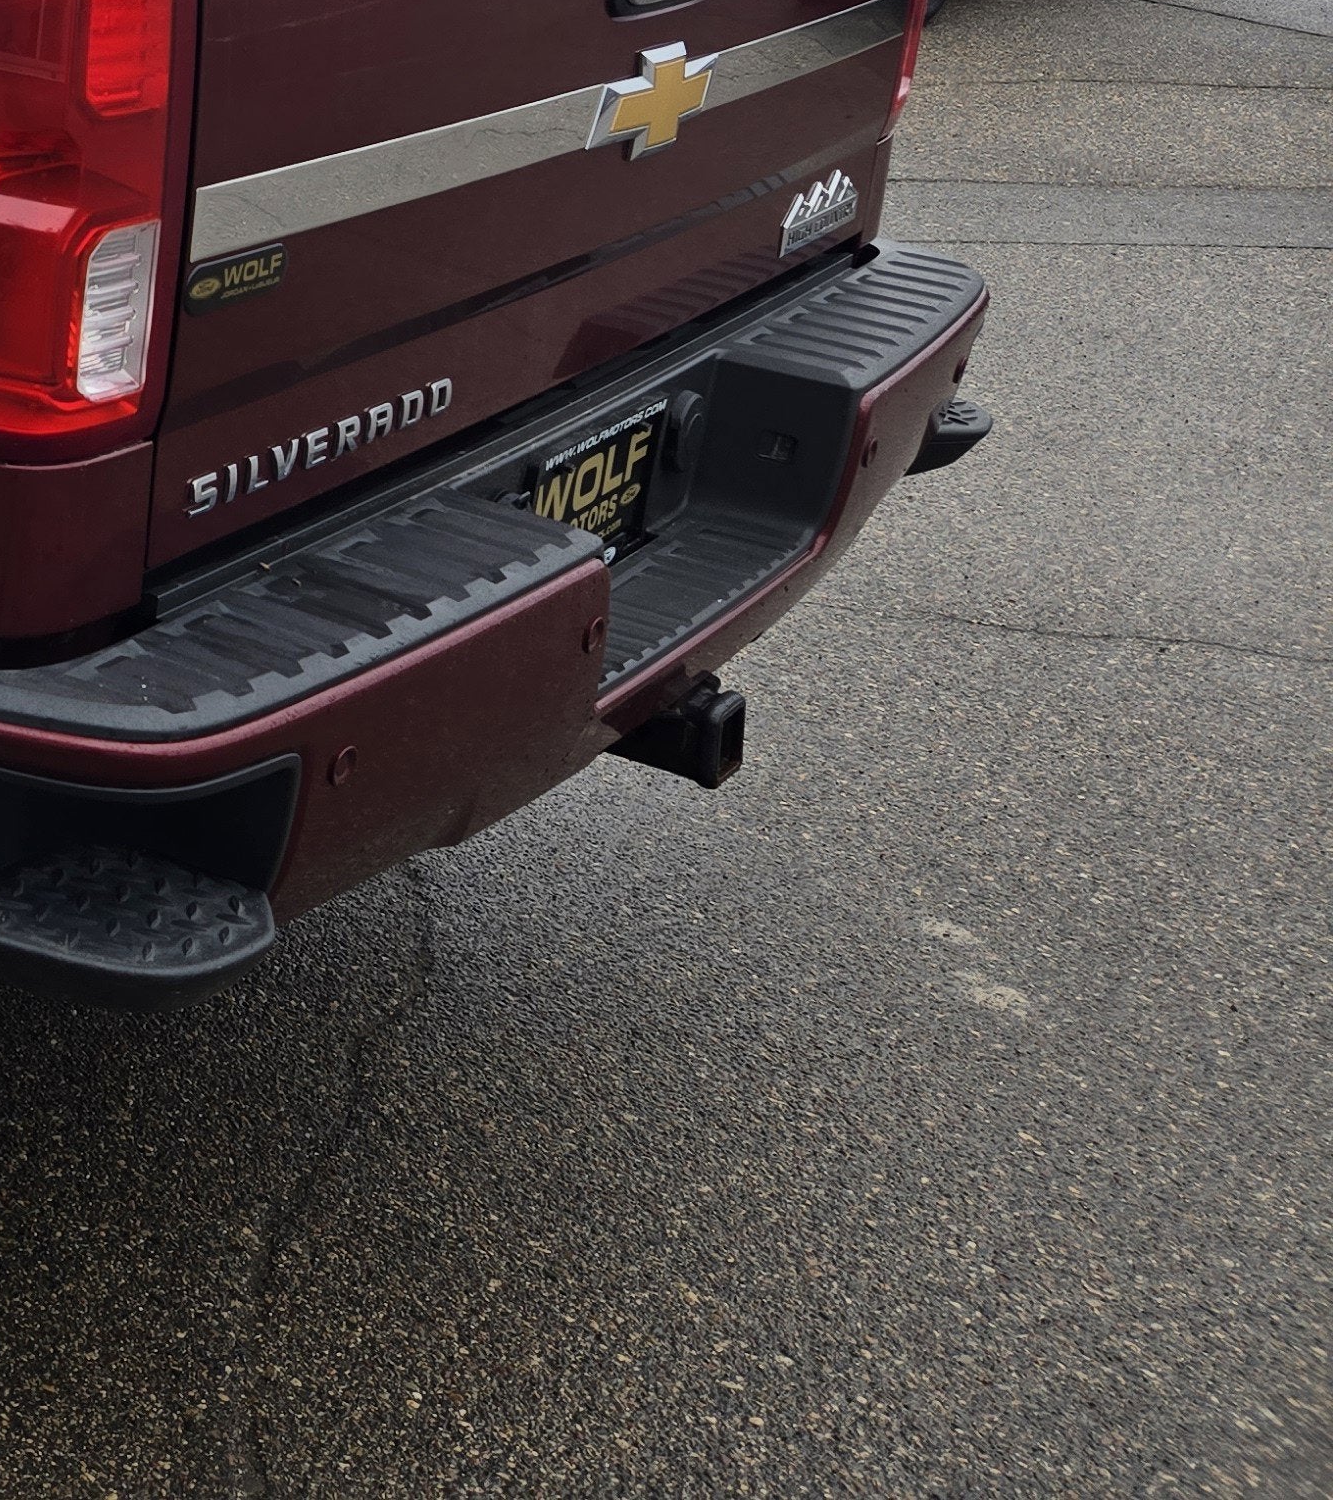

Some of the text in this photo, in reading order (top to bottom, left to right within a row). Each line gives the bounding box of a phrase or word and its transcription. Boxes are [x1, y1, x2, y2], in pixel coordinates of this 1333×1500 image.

[224, 252, 283, 287] WOLF
[186, 377, 453, 519] SILVERADO
[545, 398, 668, 472] WWW.WOLFMOTORS.COM
[535, 425, 653, 522] WOLF
[569, 493, 618, 531] OTORS
